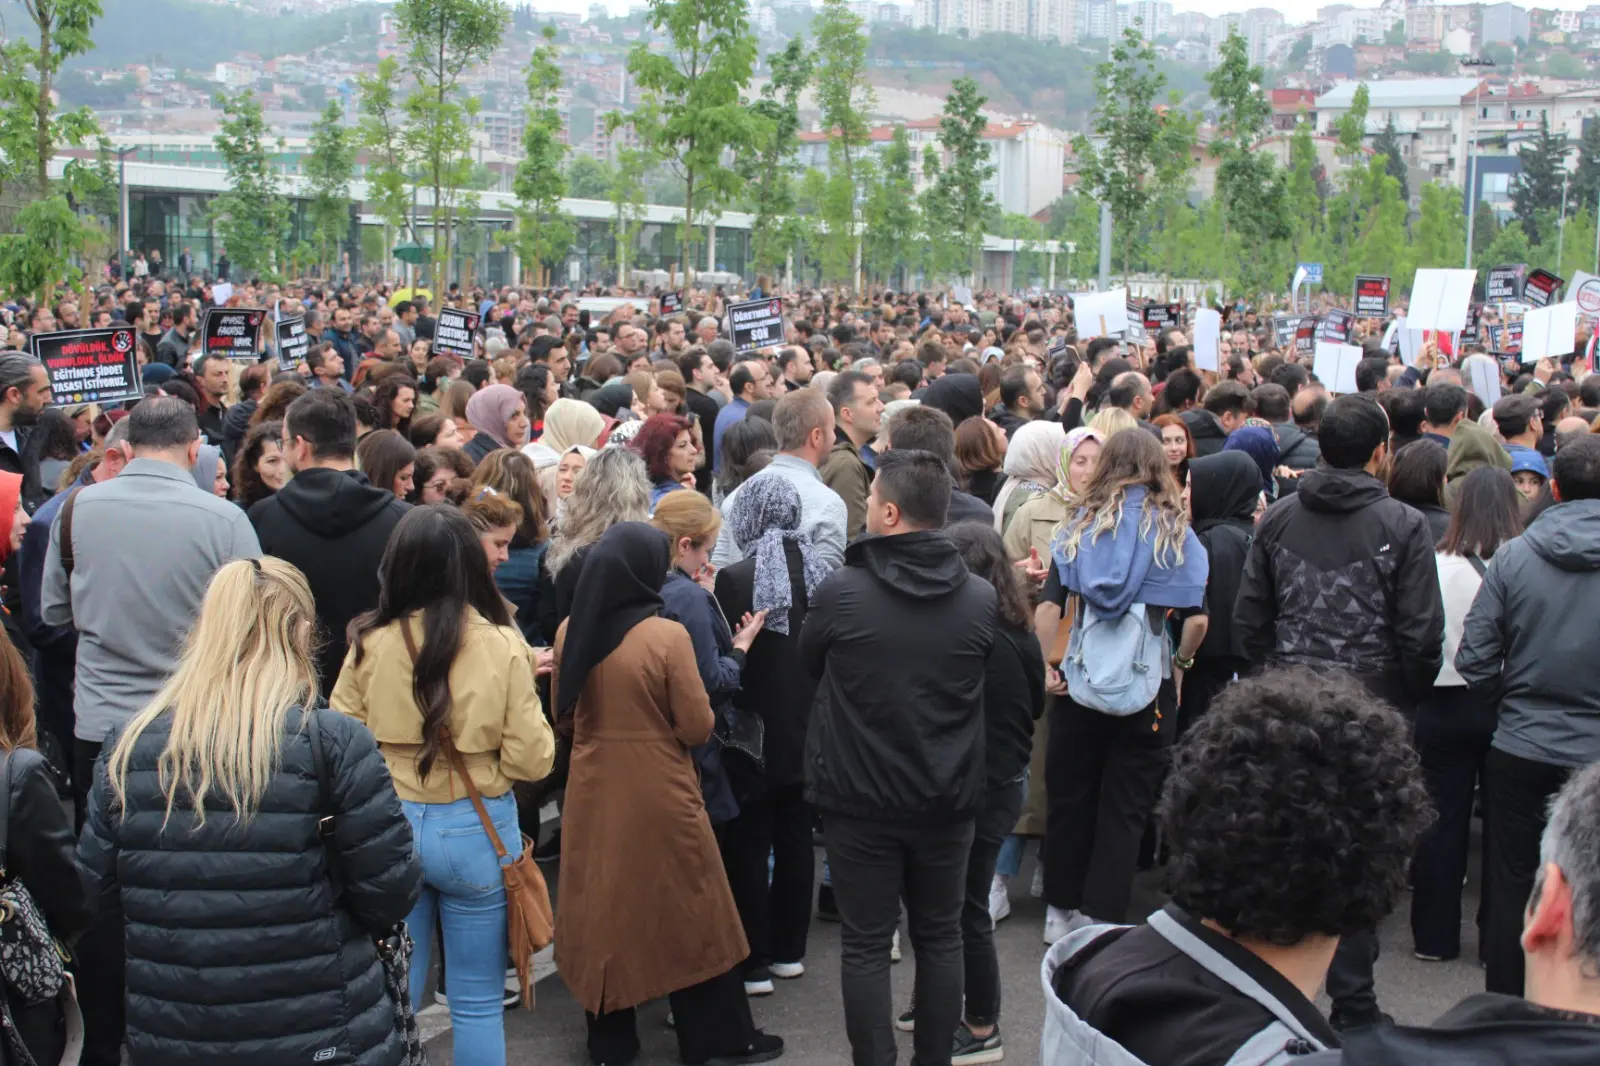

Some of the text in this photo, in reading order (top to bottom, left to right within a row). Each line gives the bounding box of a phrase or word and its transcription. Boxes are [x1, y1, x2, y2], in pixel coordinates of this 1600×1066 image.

[440, 314, 465, 329] SUSMA
[438, 326, 469, 342] SUSTUKÇA
[751, 327, 769, 341] SON
[98, 351, 125, 364] ÖLDÜK
[53, 364, 123, 381] EĞİTİMDE ŞİDDET
[52, 377, 128, 393] YASASI İSTİYORUZ.
